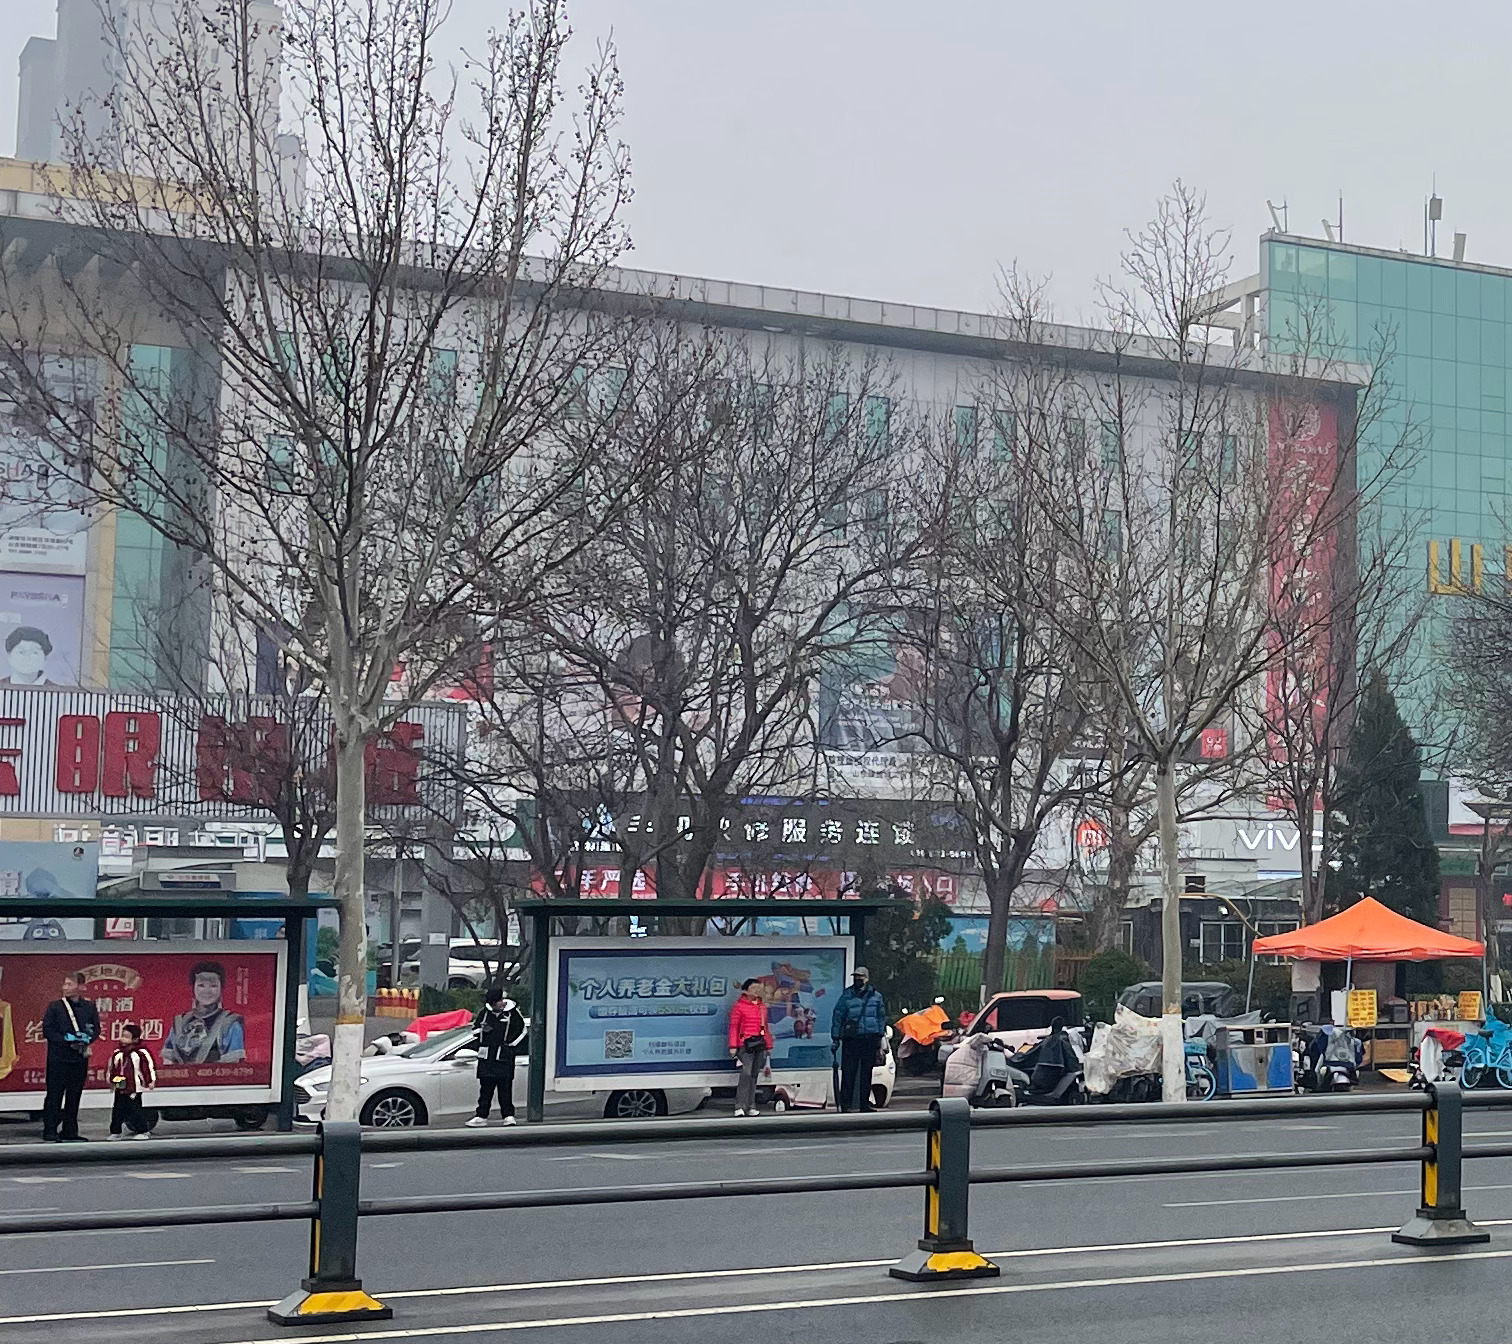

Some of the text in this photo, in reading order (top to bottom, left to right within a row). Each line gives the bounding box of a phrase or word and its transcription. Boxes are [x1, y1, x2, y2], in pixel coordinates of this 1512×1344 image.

[580, 977, 727, 1000] 个人养老金大礼包
[24, 1018, 163, 1044] 给的酒
